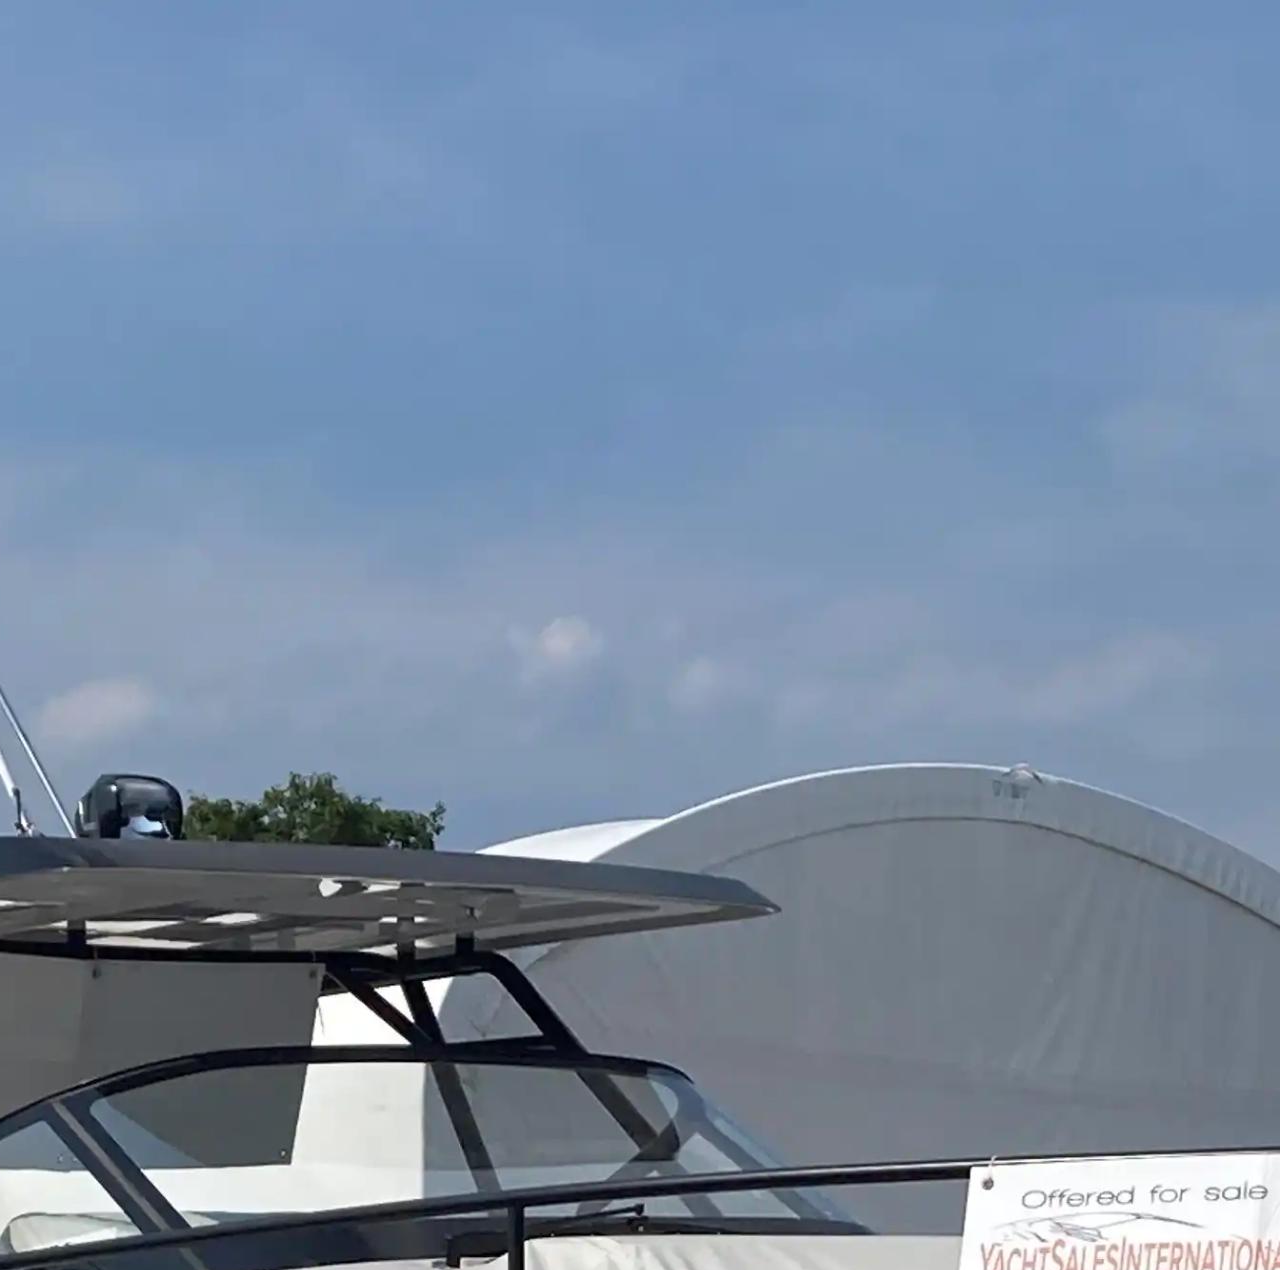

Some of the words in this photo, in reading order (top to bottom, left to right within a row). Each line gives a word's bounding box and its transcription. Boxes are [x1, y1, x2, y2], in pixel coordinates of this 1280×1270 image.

[1022, 1186, 1135, 1209] Offered
[1150, 1184, 1191, 1203] for
[1204, 1180, 1269, 1202] sale
